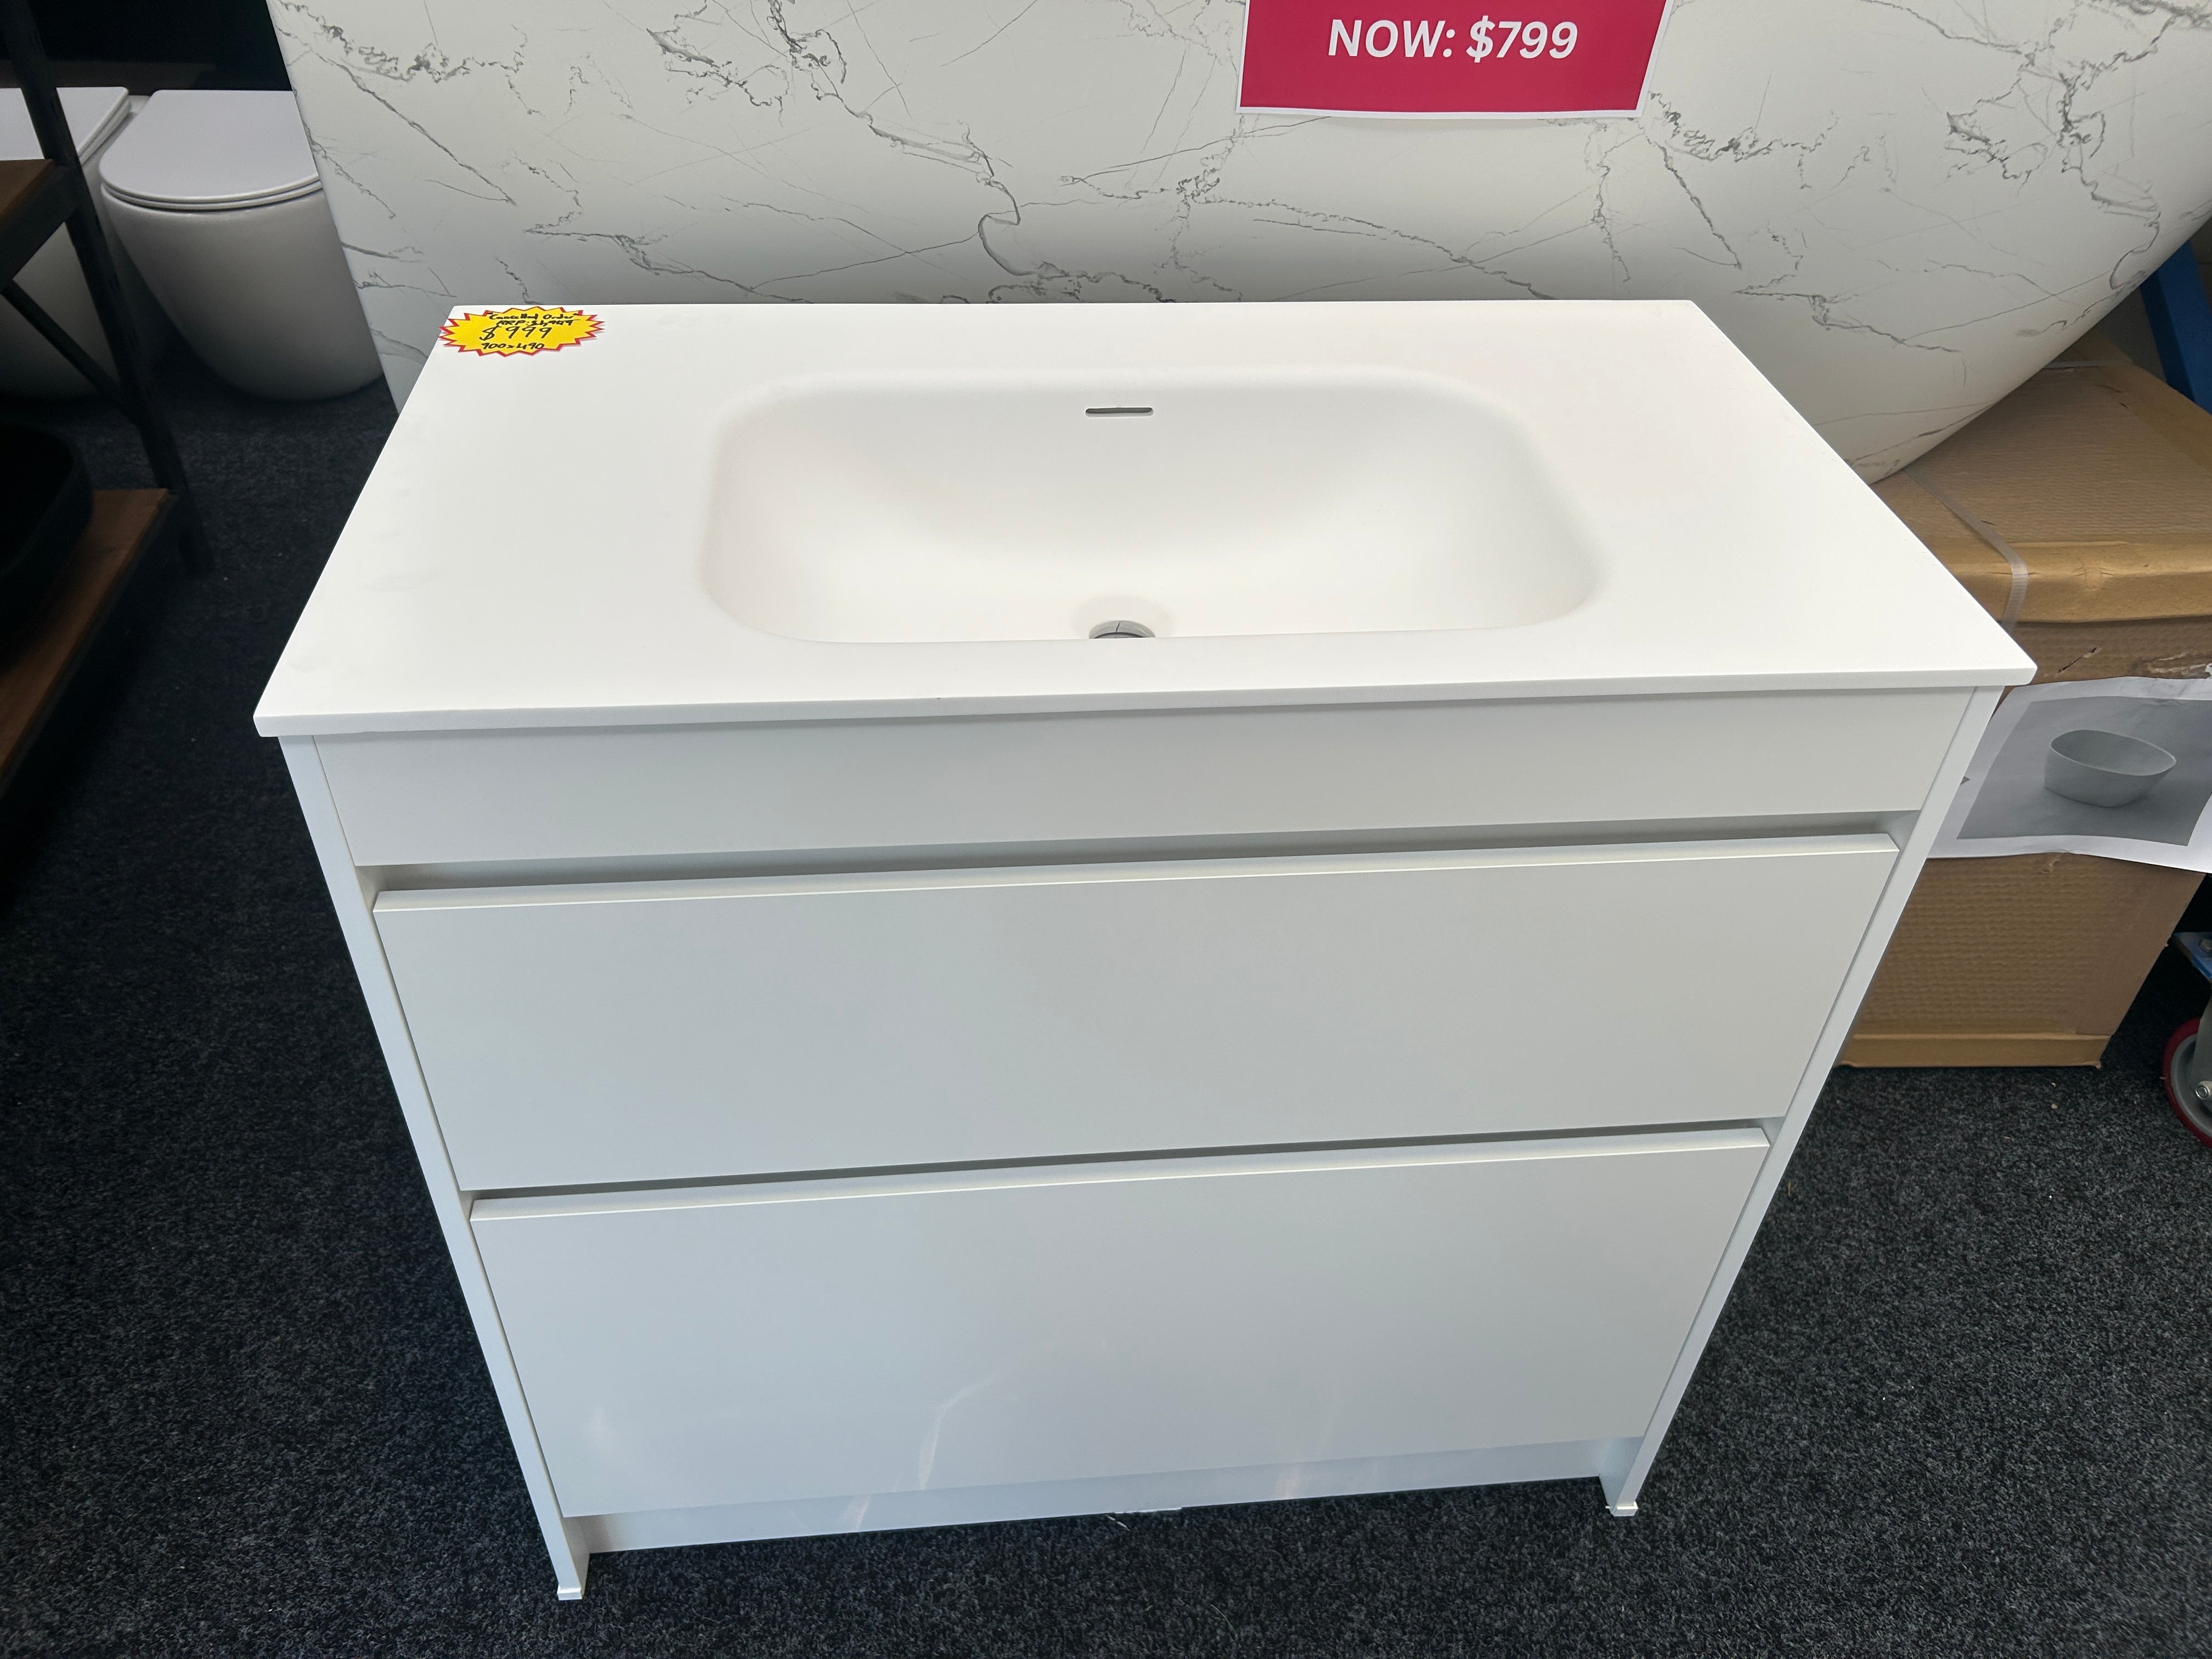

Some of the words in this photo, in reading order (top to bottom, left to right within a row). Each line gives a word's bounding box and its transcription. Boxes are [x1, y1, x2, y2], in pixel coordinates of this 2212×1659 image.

[1328, 19, 1456, 58] NOW:
[1466, 15, 1578, 63] $799
[479, 325, 552, 341] $999
[481, 342, 545, 350] 900x490
